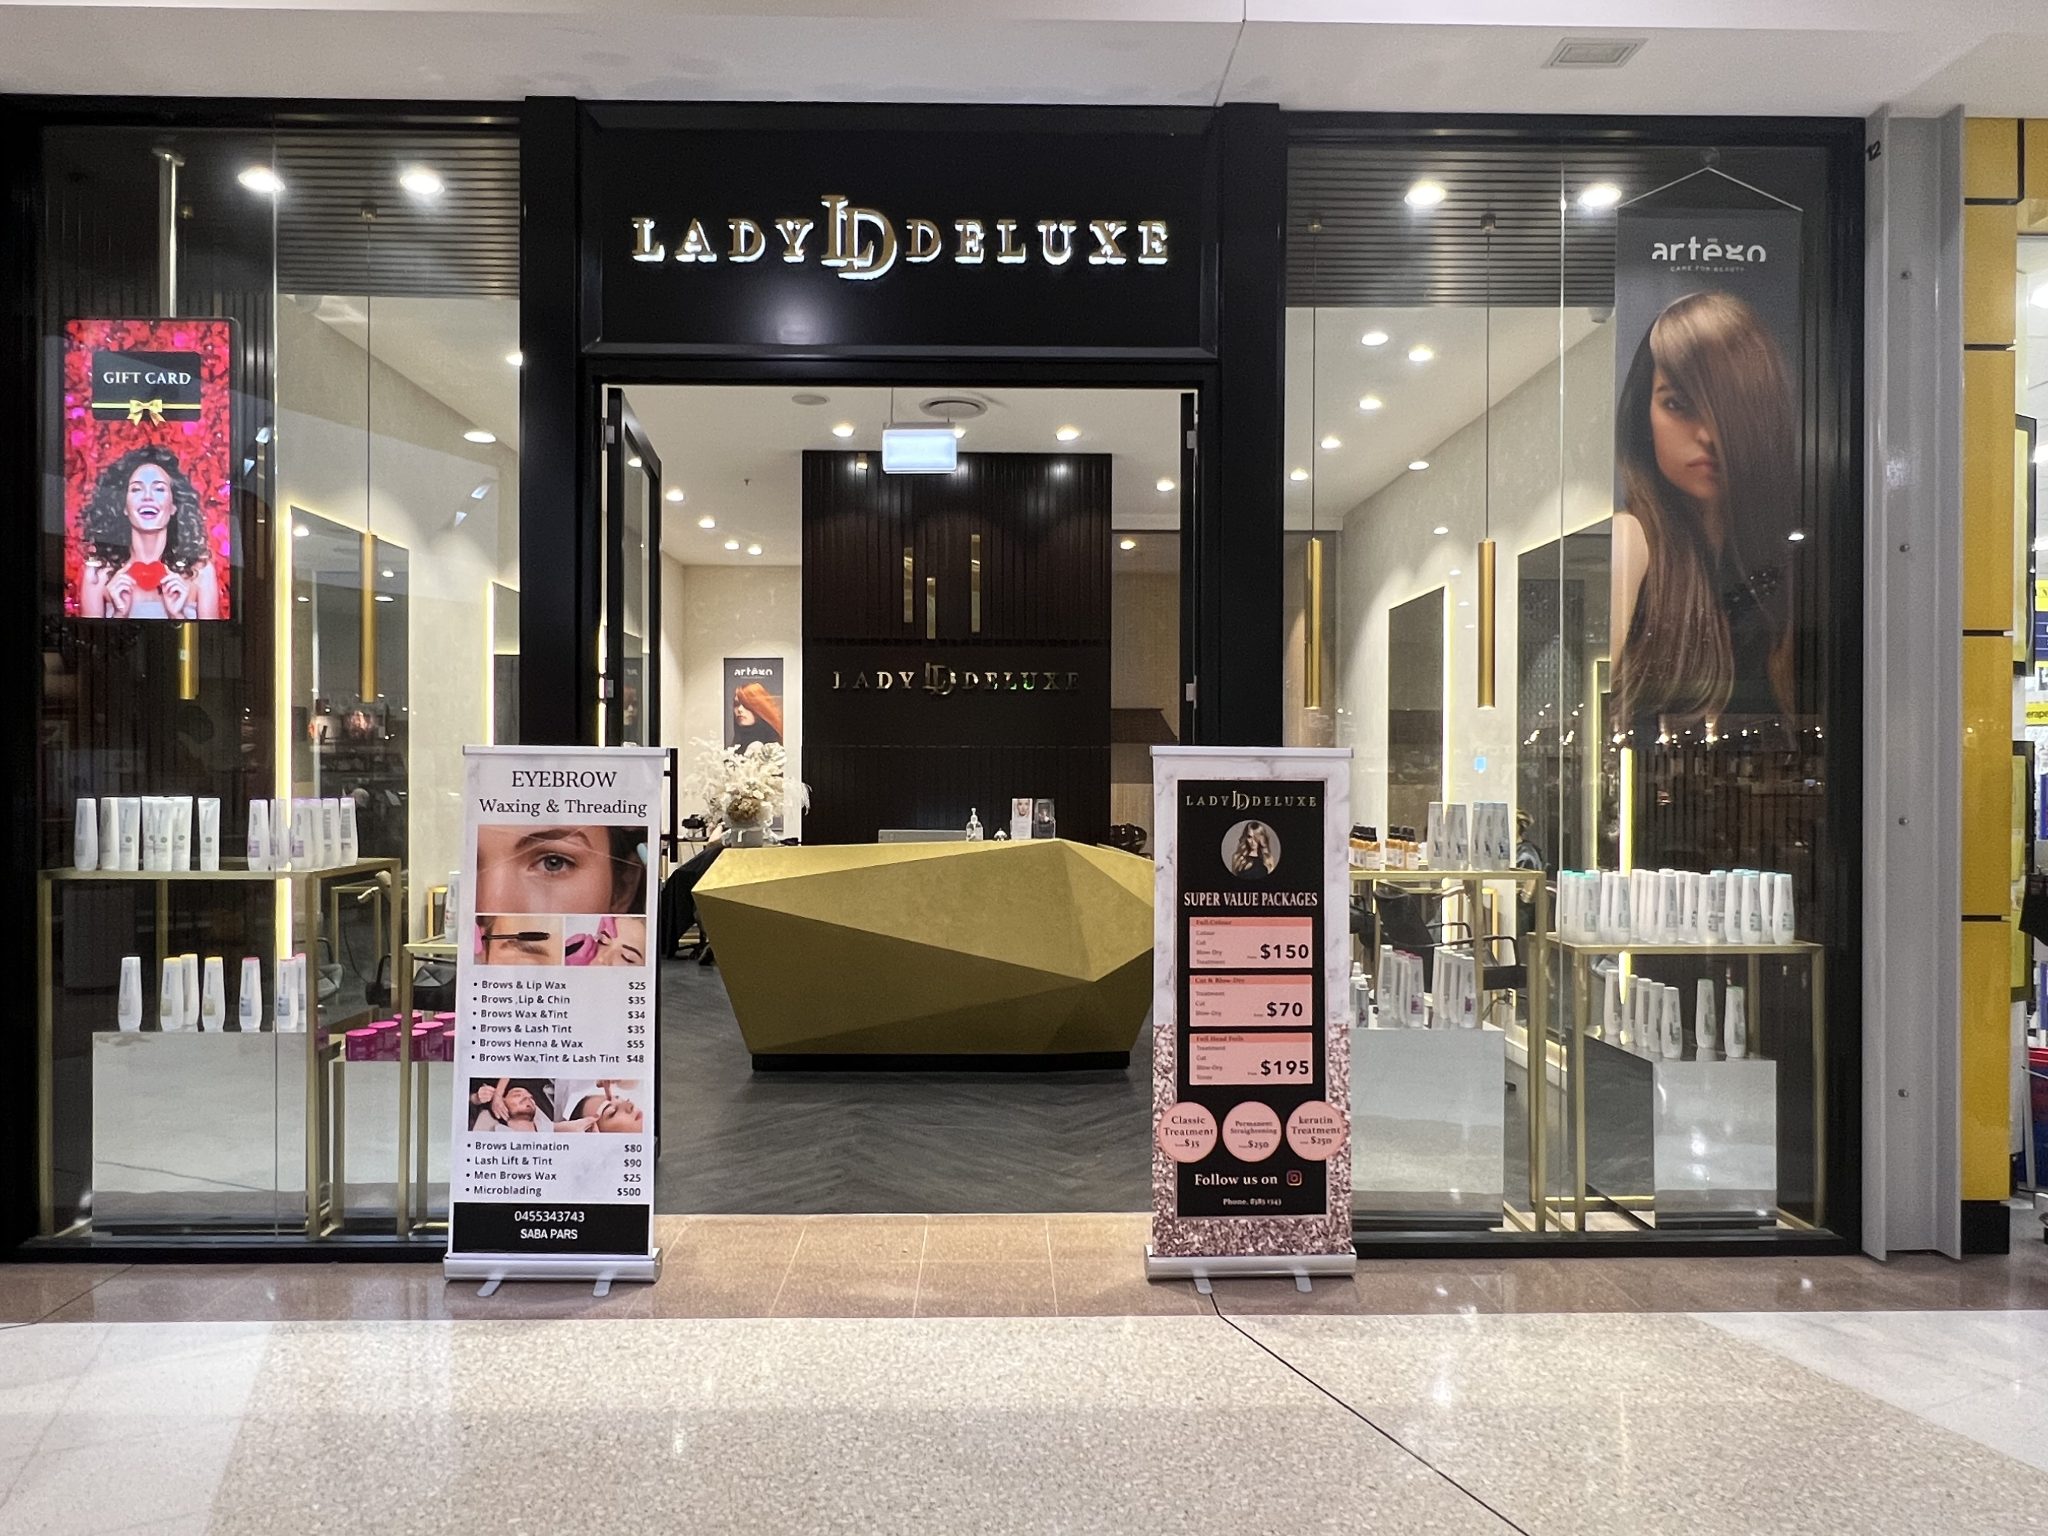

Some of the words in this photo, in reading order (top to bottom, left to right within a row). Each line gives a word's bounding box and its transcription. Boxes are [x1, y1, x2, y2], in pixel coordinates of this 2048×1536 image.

[631, 217, 814, 263] LADY
[905, 218, 1168, 266] DELUXE
[103, 371, 141, 384] GIFT
[144, 371, 192, 385] CARD
[832, 671, 915, 690] LADY
[962, 671, 1080, 690] DELUXE
[511, 770, 617, 788] EYEBROW
[1186, 795, 1230, 807] LADY
[1252, 796, 1317, 807] DELUXE
[479, 798, 541, 817] Waxing
[546, 799, 560, 813] &
[564, 799, 648, 818] Threading
[1184, 892, 1221, 907] SUPER
[1223, 892, 1259, 907] VALUE
[1261, 892, 1318, 907] PACKAGES
[1260, 943, 1309, 960] $150
[482, 981, 513, 990] Brows
[516, 981, 523, 990] &
[526, 981, 542, 992] Lip
[544, 981, 567, 990] Wax
[628, 982, 646, 991] $25
[481, 995, 513, 1004] Brows
[536, 996, 544, 1005] &
[547, 996, 570, 1005] Chin
[628, 996, 646, 1005] $35
[481, 1010, 512, 1019] Brows
[515, 1010, 537, 1019] Wax
[627, 1011, 645, 1020] $34
[1266, 1001, 1303, 1018] $70
[480, 1024, 512, 1033] Brows
[514, 1025, 522, 1033] &
[525, 1025, 549, 1034] Lash
[552, 1025, 572, 1034] Tint
[627, 1025, 645, 1034] $35
[479, 1039, 511, 1048] Brows
[514, 1039, 548, 1048] Henna
[551, 1039, 558, 1048] &
[561, 1040, 584, 1048] Wax
[627, 1040, 645, 1049] $55
[479, 1053, 511, 1062] Brows
[562, 1054, 569, 1063] &
[572, 1054, 596, 1063] Lash
[599, 1054, 620, 1063] Tint
[626, 1054, 644, 1064] $48
[1260, 1059, 1309, 1076] $195
[1171, 1115, 1206, 1125] Classic
[1163, 1127, 1214, 1136] Treatment
[1290, 1126, 1341, 1135] Treatment
[475, 1141, 507, 1150] Brows
[510, 1142, 570, 1150] Lamination
[624, 1144, 642, 1153] $80
[474, 1156, 498, 1165] Lash
[501, 1156, 519, 1165] Lift
[522, 1156, 529, 1165] &
[532, 1156, 553, 1165] Tint
[623, 1158, 642, 1167] $90
[474, 1171, 496, 1180] Men
[499, 1171, 532, 1180] Brows
[535, 1171, 557, 1180] Wax
[623, 1173, 641, 1182] $25
[1194, 1173, 1239, 1186] Follow
[1243, 1175, 1258, 1185] us
[1261, 1175, 1278, 1185] on
[473, 1185, 542, 1196] Microblading
[616, 1188, 641, 1197] $500
[514, 1210, 585, 1222] 0455343743
[520, 1228, 548, 1239] SABA
[549, 1229, 578, 1240] PARS
